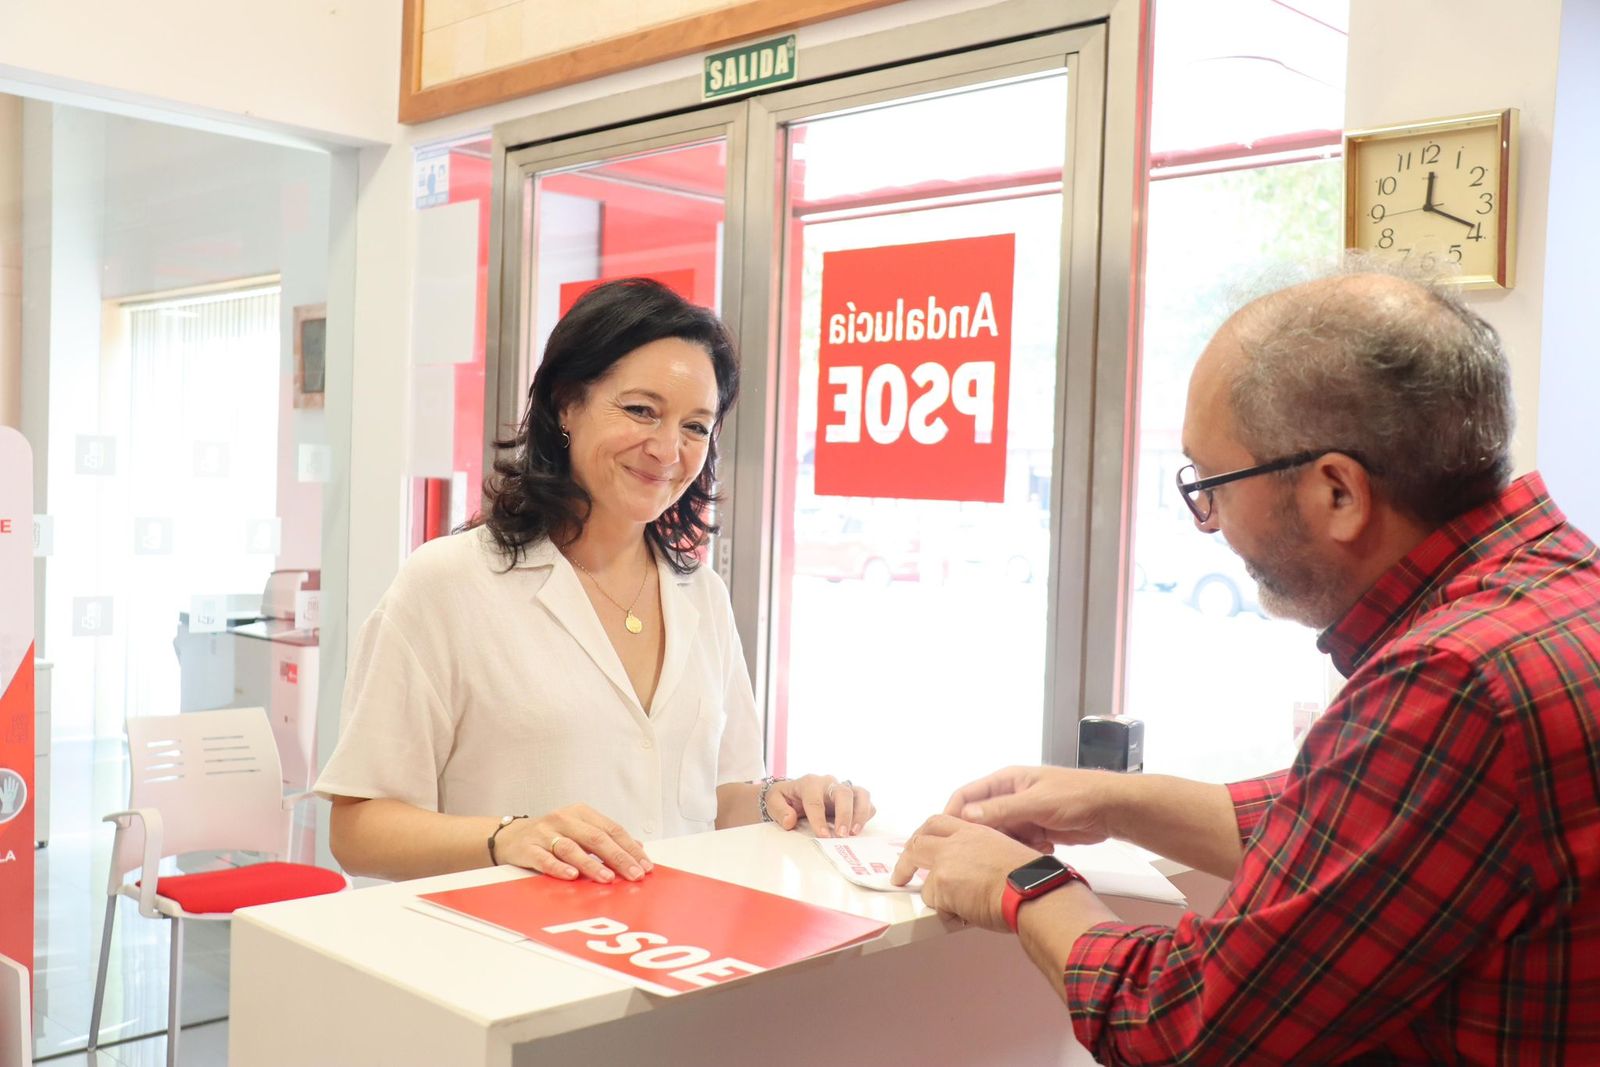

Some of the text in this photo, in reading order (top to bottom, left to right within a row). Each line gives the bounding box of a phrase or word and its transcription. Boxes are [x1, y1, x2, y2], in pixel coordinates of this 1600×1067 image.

[710, 44, 789, 90] SALIDA
[1398, 151, 1412, 173] 11
[1420, 143, 1441, 165] 12
[1455, 150, 1462, 169] 1
[1377, 176, 1397, 196] 10
[1468, 166, 1486, 187] 2
[1370, 203, 1386, 224] 9
[1475, 192, 1493, 215] 3
[1377, 227, 1394, 249] 8
[1466, 221, 1483, 243] 4
[1448, 244, 1463, 264] 5
[541, 917, 768, 988] PSOE
